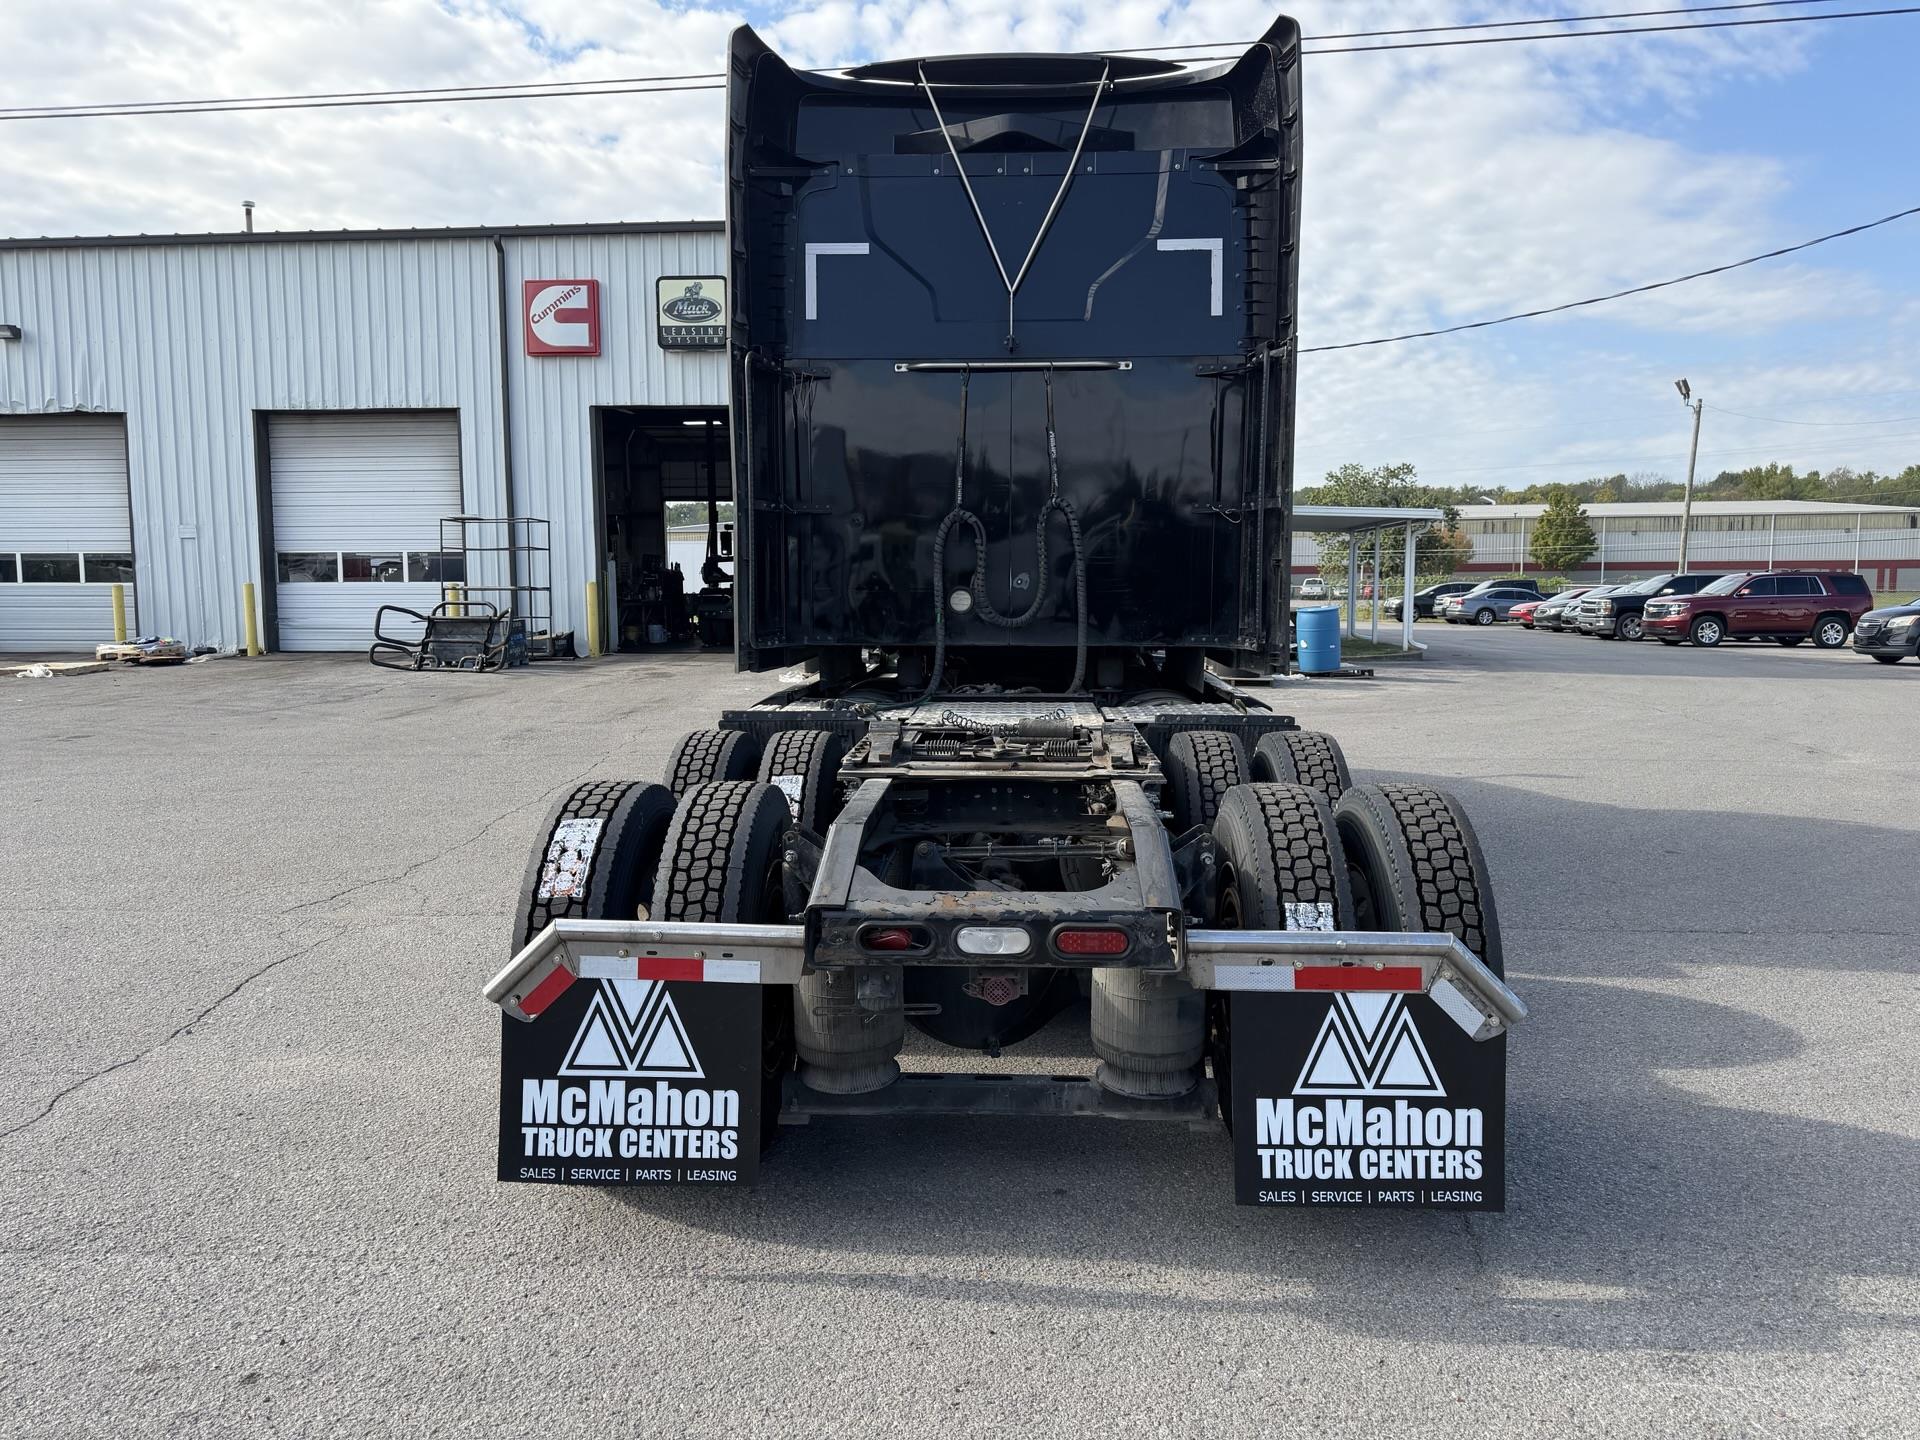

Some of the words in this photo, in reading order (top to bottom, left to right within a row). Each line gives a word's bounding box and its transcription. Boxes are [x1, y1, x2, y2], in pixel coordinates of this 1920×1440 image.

[531, 285, 582, 325] Cummins
[672, 300, 711, 316] Mack
[662, 327, 724, 336] LEASING
[668, 336, 719, 344] SYSTEM
[522, 1079, 739, 1127] McMahon
[1256, 1098, 1483, 1147] McMahon
[521, 1128, 614, 1157] TRUCK
[620, 1129, 738, 1159] CENTERS
[520, 1167, 556, 1179] SALES
[570, 1168, 621, 1180] SERVICE
[635, 1169, 672, 1181] PARTS
[687, 1169, 737, 1182] LEASING
[1257, 1148, 1354, 1180] TRUCK
[1359, 1148, 1484, 1180] CENTERS
[1259, 1190, 1297, 1203] SALES
[1311, 1190, 1363, 1203] SERVICE
[1378, 1190, 1415, 1202] PARTS
[1430, 1190, 1483, 1202] LEASING
